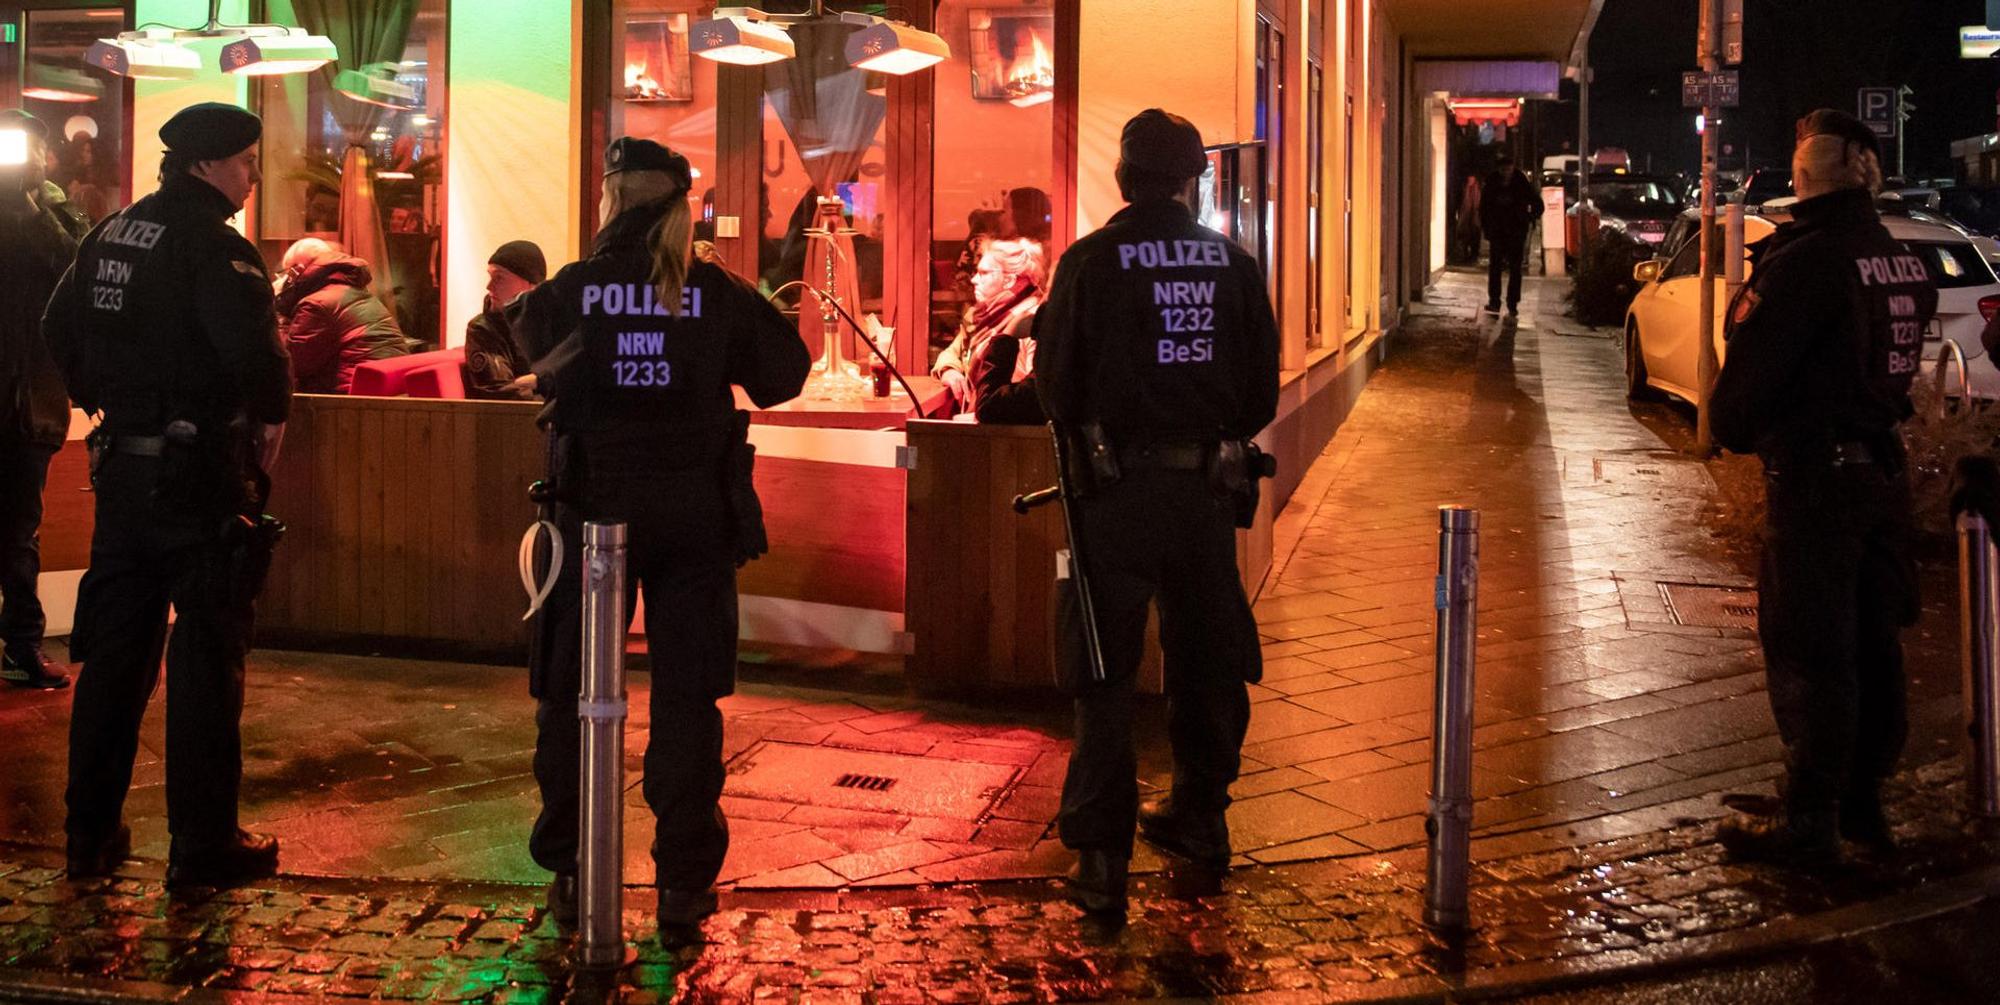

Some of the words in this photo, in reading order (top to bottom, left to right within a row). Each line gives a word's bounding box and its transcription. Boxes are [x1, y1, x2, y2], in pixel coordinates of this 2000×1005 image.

[1867, 92, 1887, 118] P
[1118, 239, 1230, 269] POLIZEI
[96, 258, 132, 284] NRW
[1856, 256, 1928, 285] POLIZEI
[93, 286, 123, 311] 1233
[1153, 281, 1216, 305] NRW
[1160, 307, 1215, 332] 1232
[617, 332, 665, 356] NRW
[1157, 337, 1213, 363] BeSi
[612, 361, 671, 387] 1233
[1888, 350, 1918, 374] BeS
